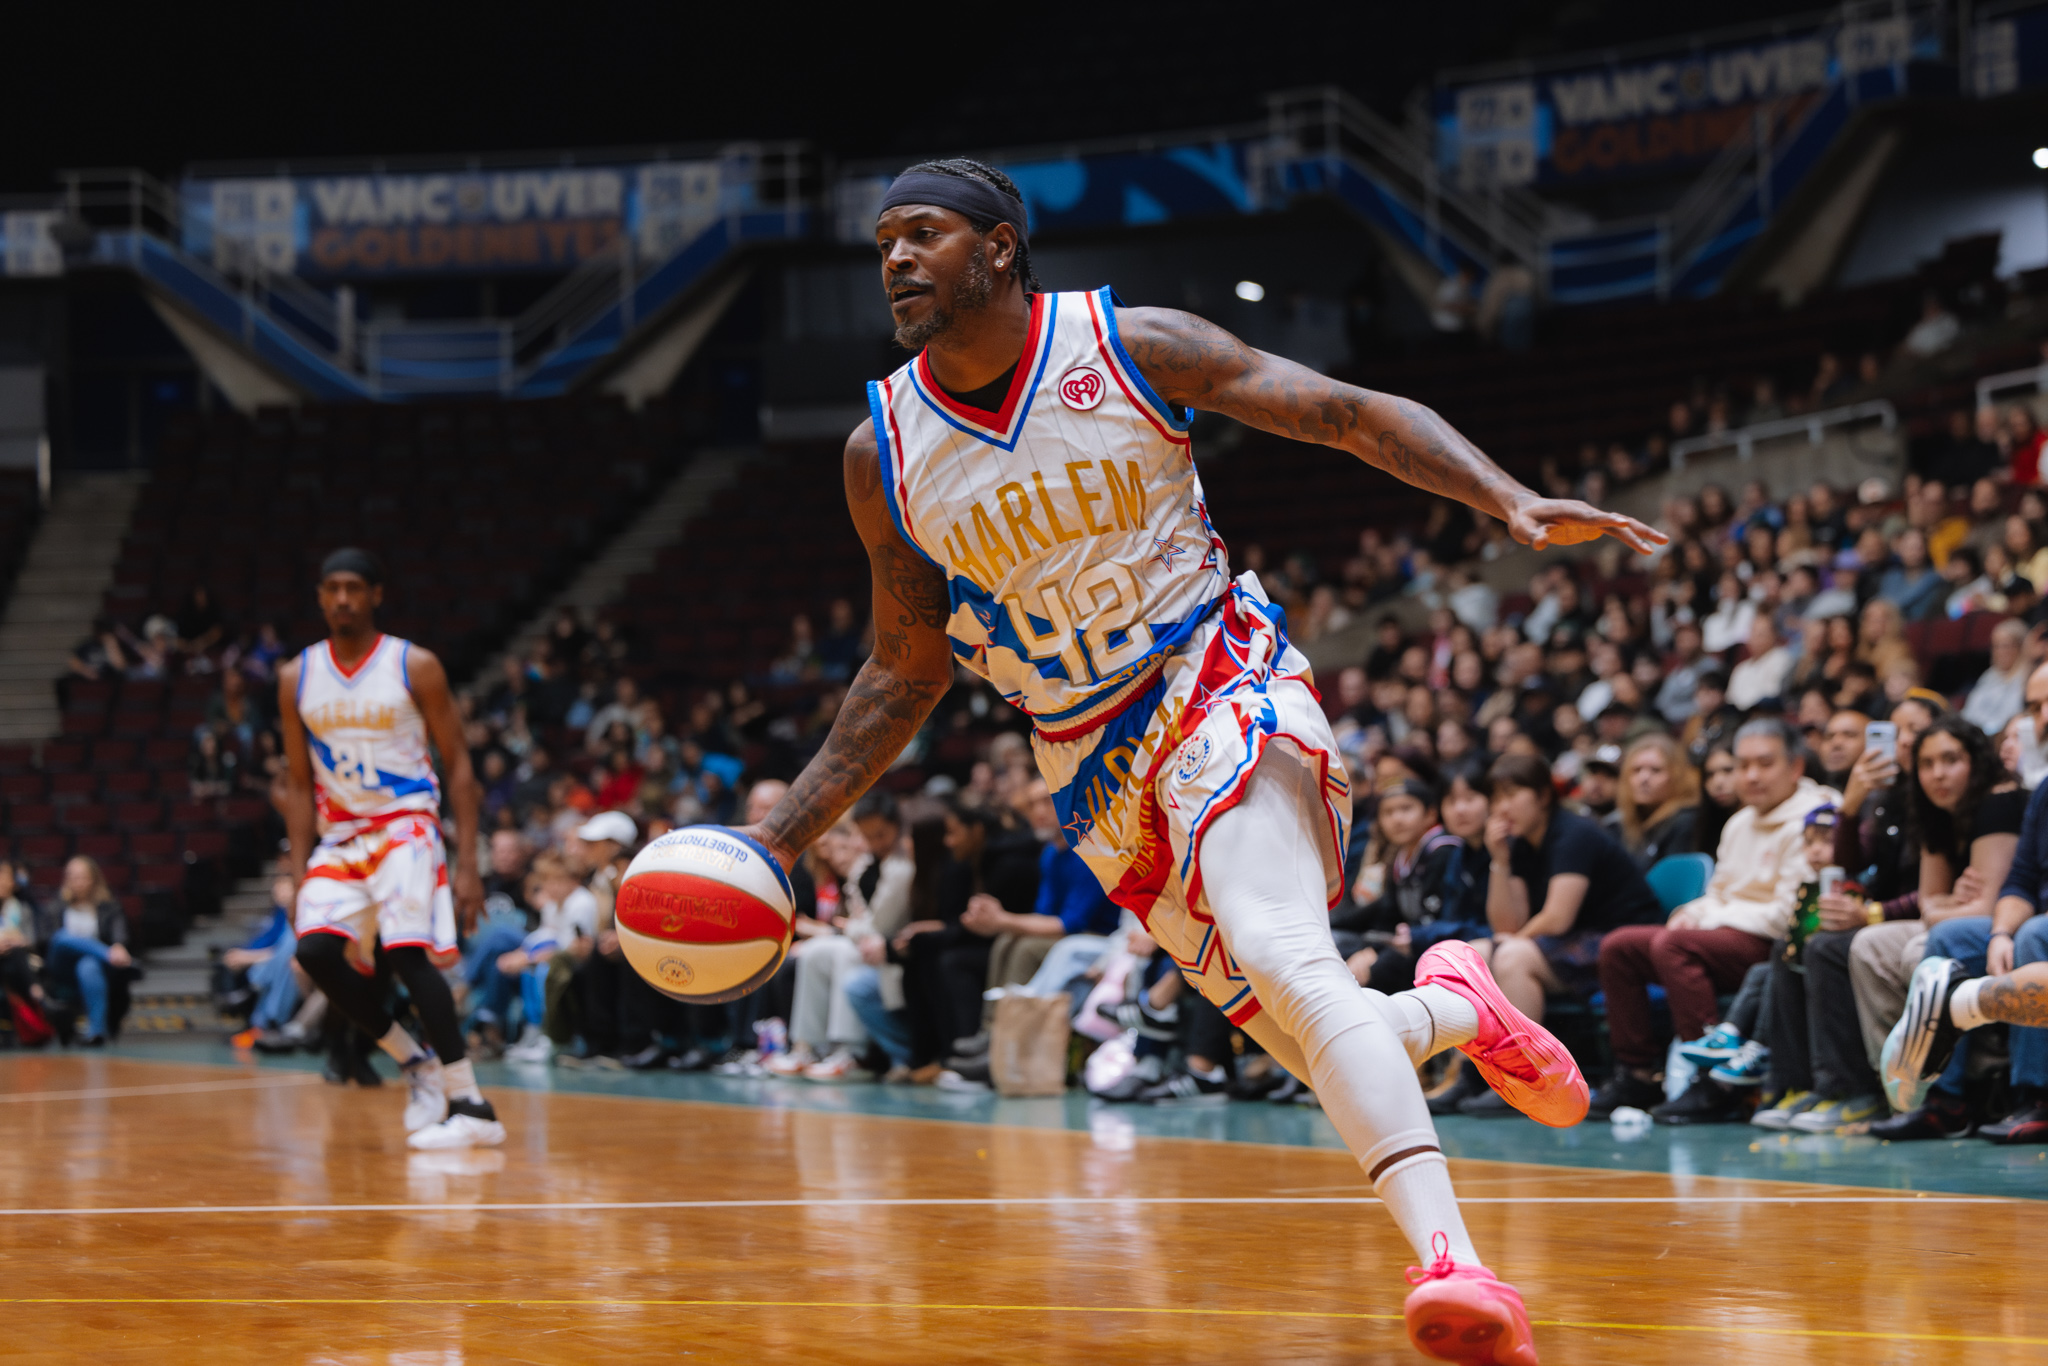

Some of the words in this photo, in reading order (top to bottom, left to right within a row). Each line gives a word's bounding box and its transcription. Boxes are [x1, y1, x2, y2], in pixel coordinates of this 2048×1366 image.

[943, 459, 1149, 593] HARLEM
[1003, 560, 1155, 687] 42
[332, 739, 381, 790] 21
